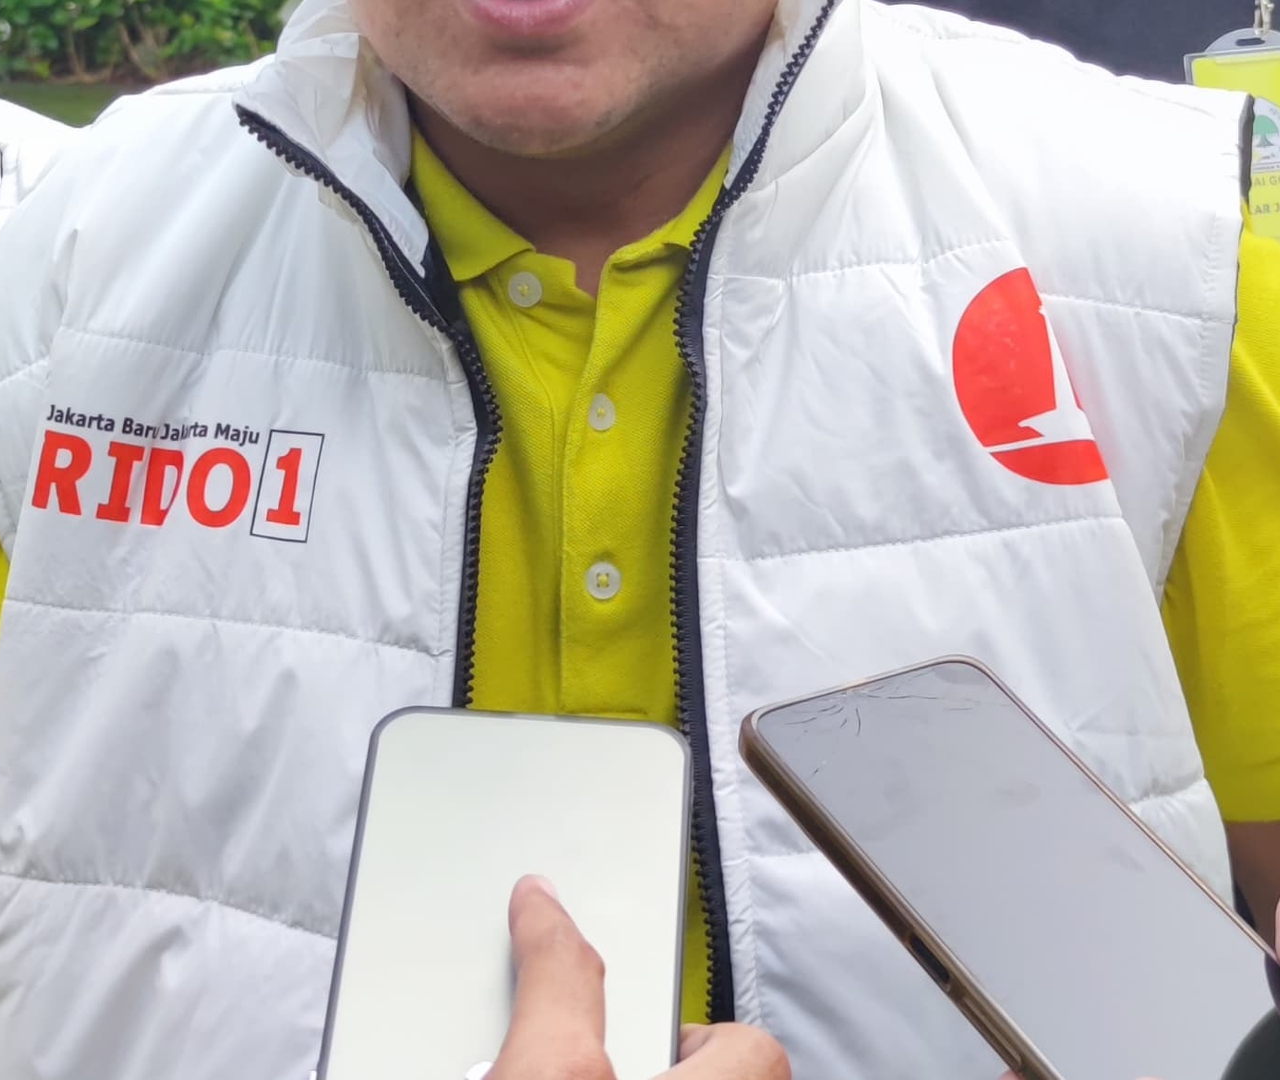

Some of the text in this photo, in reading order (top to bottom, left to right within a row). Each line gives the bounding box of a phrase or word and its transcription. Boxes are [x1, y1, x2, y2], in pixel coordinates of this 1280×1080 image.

[46, 404, 116, 432] Jakarta
[214, 422, 261, 448] Maju
[31, 429, 304, 529] RIDO 1
